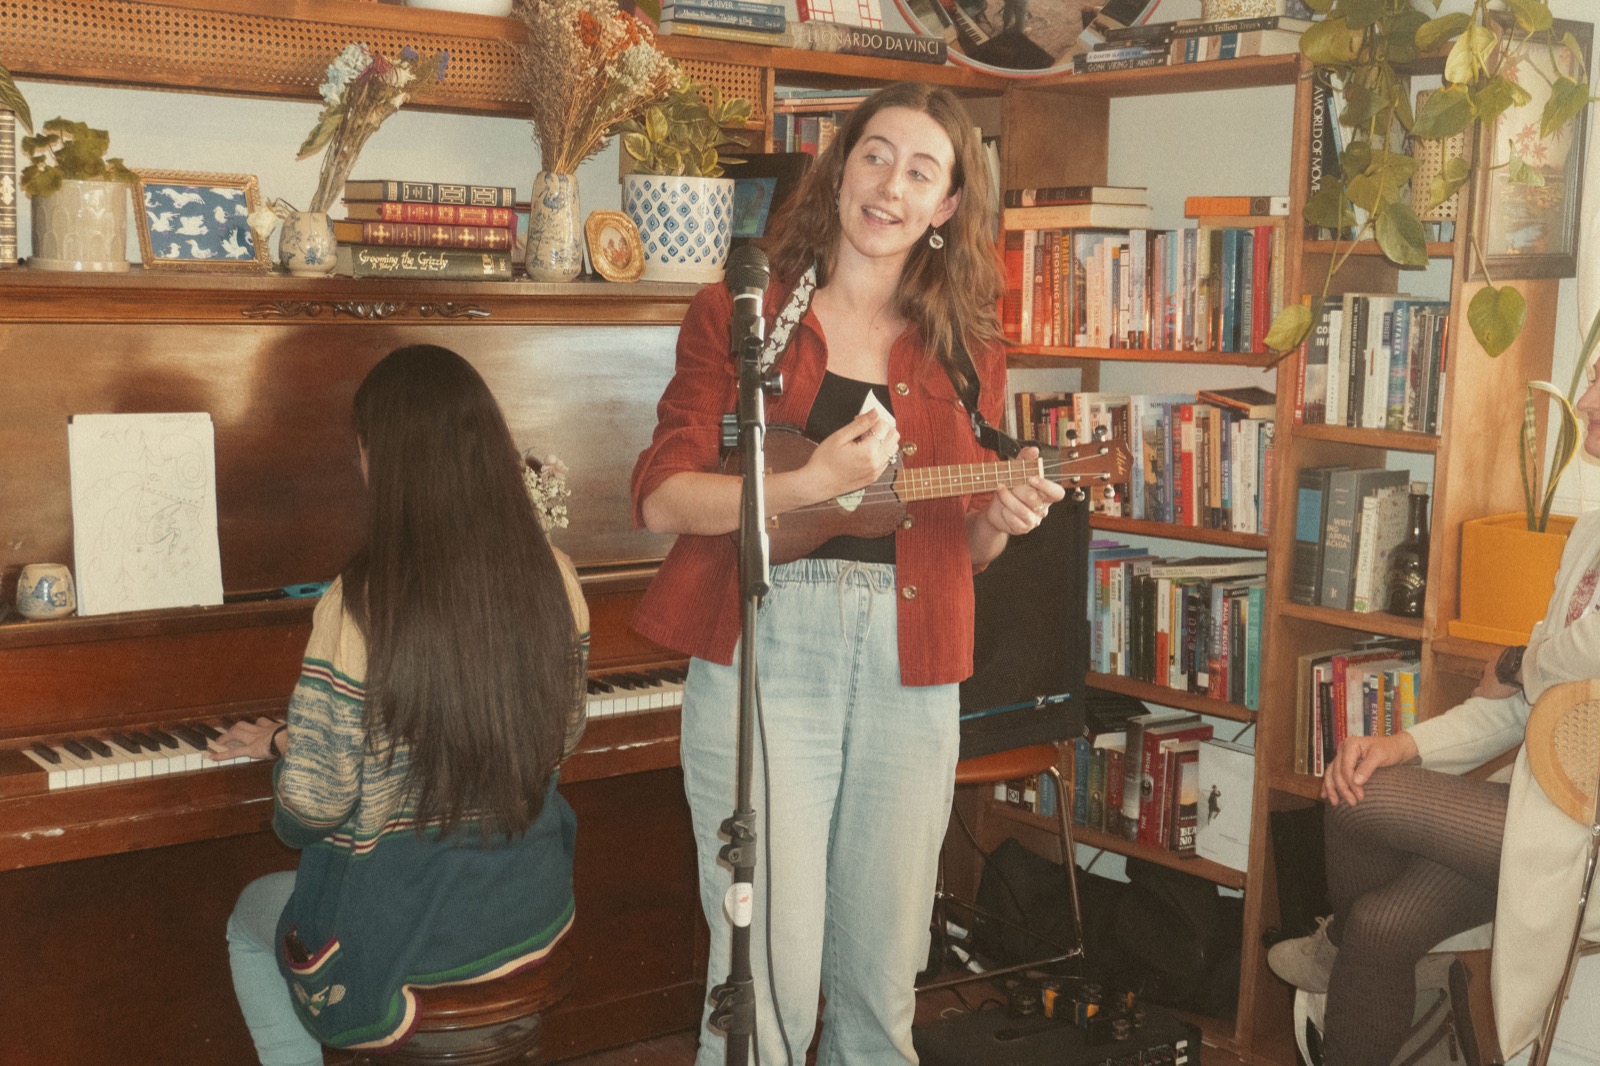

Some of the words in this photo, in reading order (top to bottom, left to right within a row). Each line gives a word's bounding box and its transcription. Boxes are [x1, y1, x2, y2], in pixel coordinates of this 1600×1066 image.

[700, 0, 712, 8] BIG
[713, 0, 734, 9] RIVER
[1215, 23, 1238, 32] Trillion
[808, 31, 883, 49] LEONARDO
[886, 36, 903, 51] DA
[904, 38, 939, 55] VINCI
[1088, 62, 1106, 72] GONE
[1107, 60, 1129, 71] VIKING
[1314, 85, 1324, 95] A
[1313, 94, 1324, 138] WORLD
[1312, 140, 1323, 156] OF
[358, 249, 399, 266] Grooming
[401, 249, 414, 265] the
[417, 251, 449, 270] Grizzly
[1062, 235, 1070, 276] TRAILED
[1394, 308, 1404, 356] WAYFARER
[1326, 524, 1339, 532] ING
[1333, 518, 1353, 527] WRIT
[1328, 532, 1351, 542] APPAL
[1326, 539, 1348, 549] ACHIA
[1144, 752, 1152, 788] DOCTRINE
[1180, 836, 1193, 846] NO
